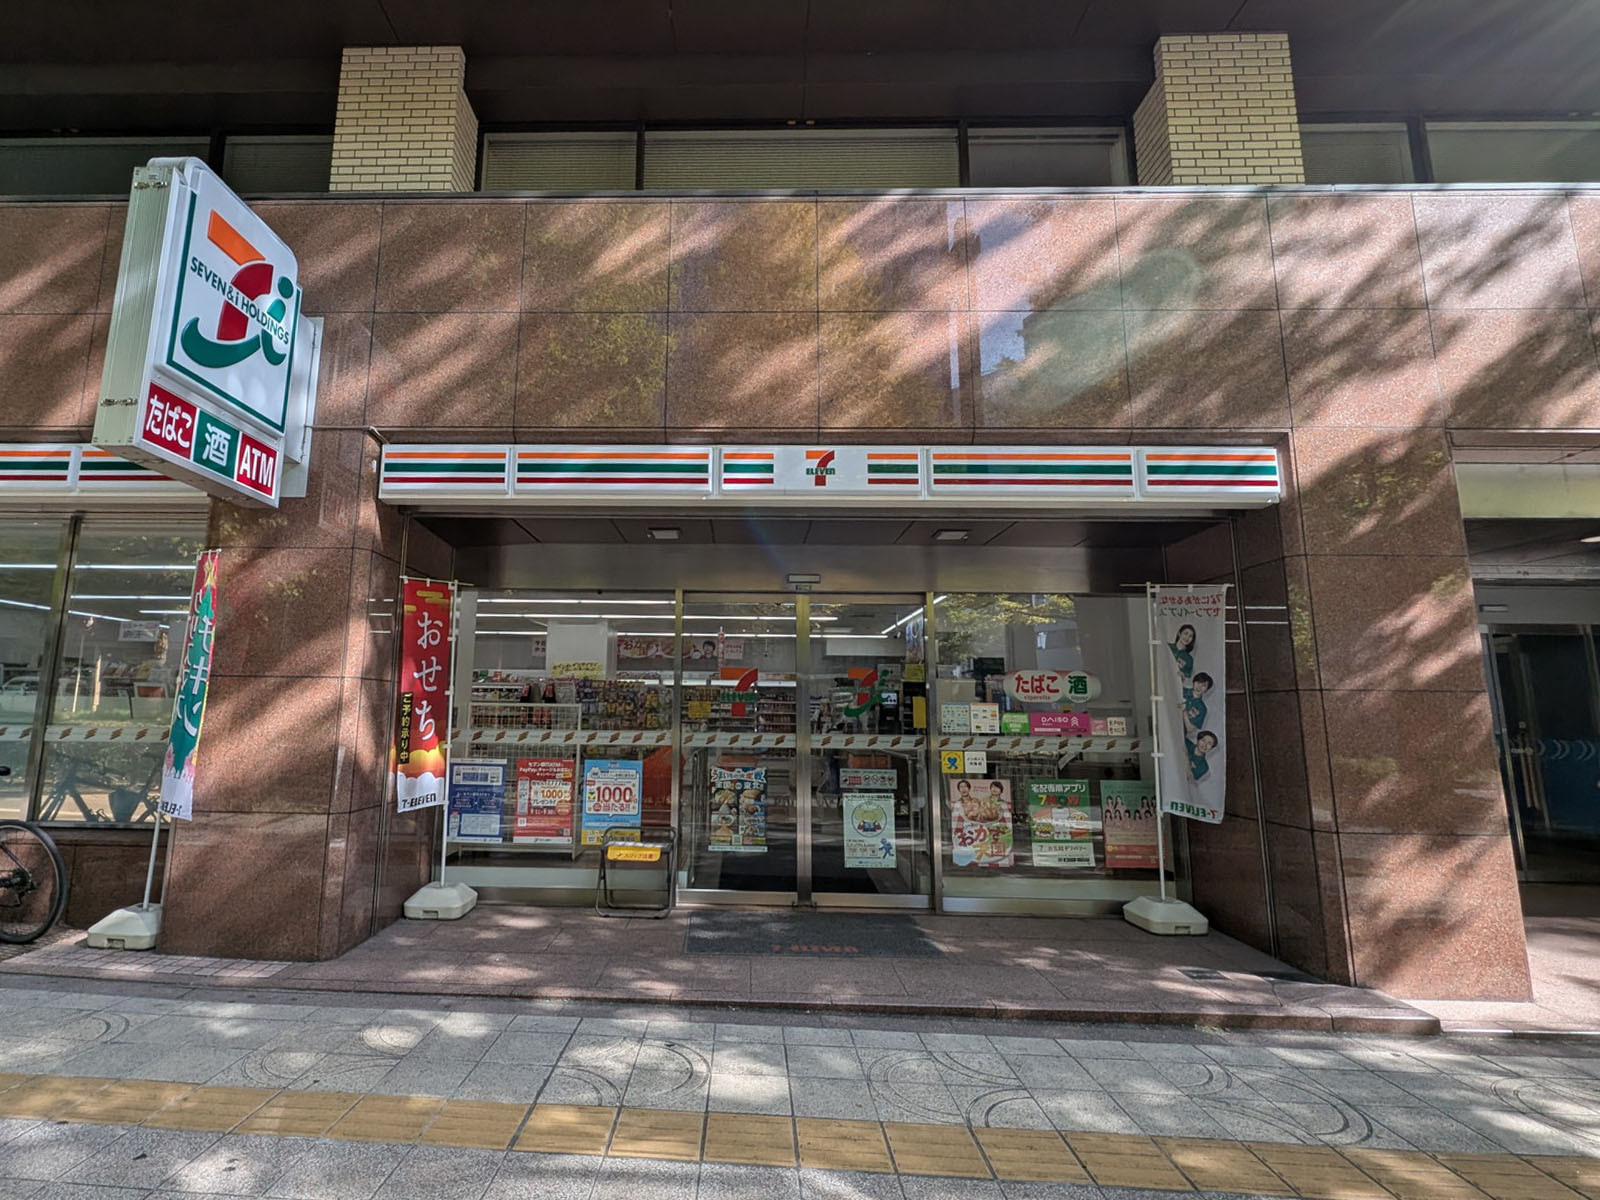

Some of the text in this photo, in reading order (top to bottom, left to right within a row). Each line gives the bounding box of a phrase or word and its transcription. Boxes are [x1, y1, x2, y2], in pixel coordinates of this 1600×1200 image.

[146, 394, 193, 449] たばこ
[202, 422, 232, 468] 酒
[239, 444, 275, 488] ATM
[413, 611, 444, 741] おせち
[1015, 674, 1088, 694] たばこ 酒
[400, 693, 413, 762] ご予約承り中
